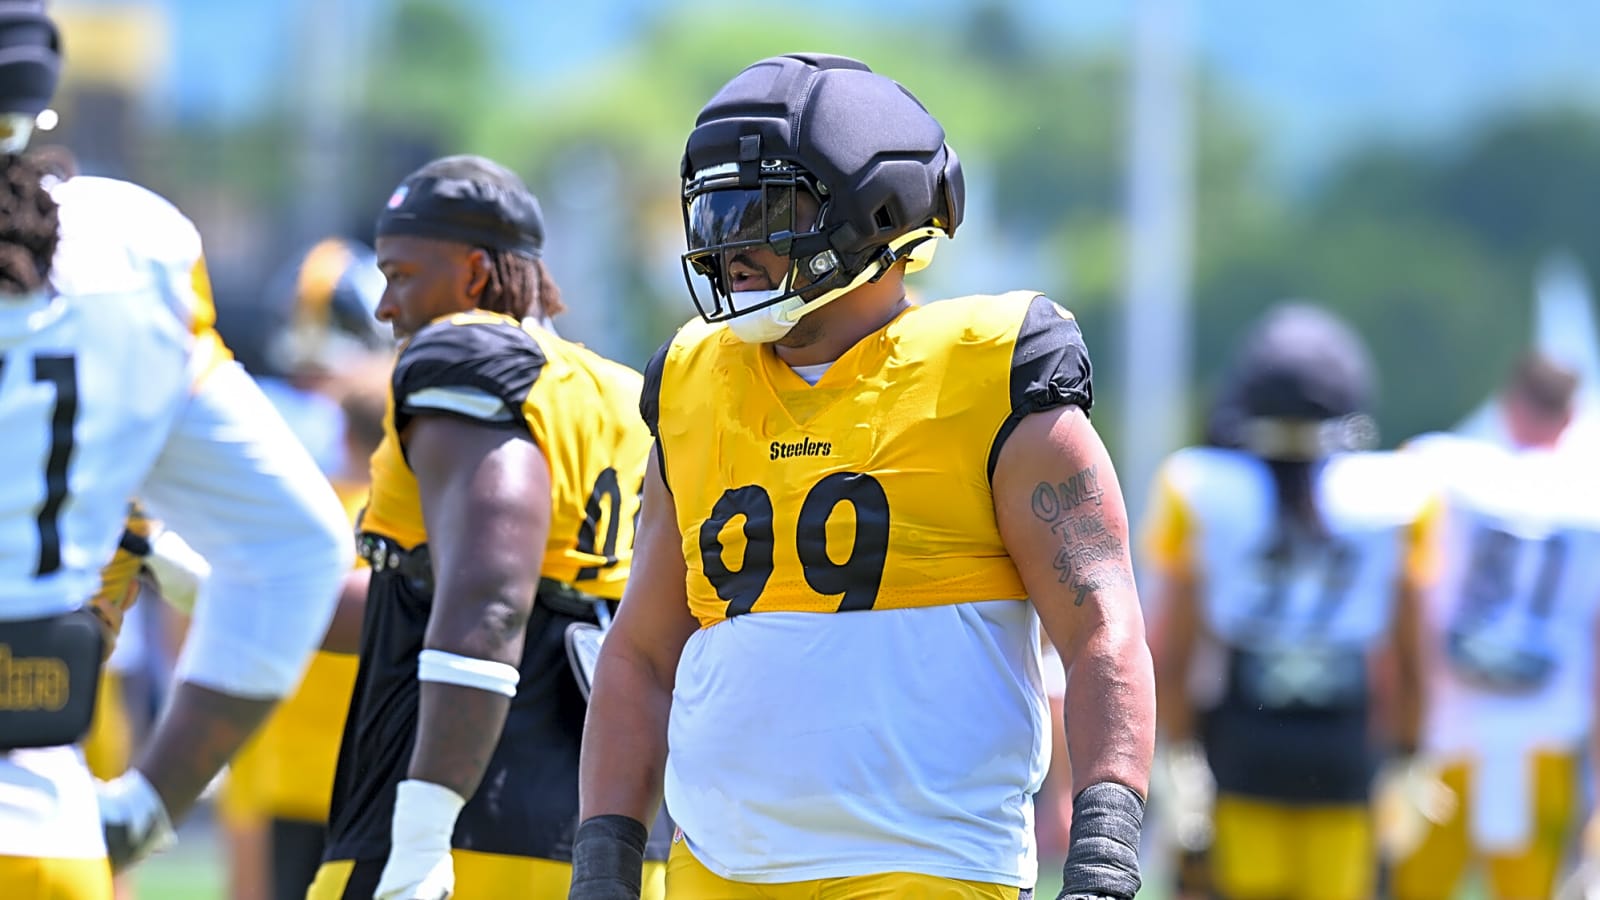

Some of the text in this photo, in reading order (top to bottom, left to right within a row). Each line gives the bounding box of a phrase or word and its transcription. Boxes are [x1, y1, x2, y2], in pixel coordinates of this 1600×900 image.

[770, 437, 832, 461] Steelers
[1031, 464, 1104, 522] ONLY
[699, 471, 891, 618] 99
[1052, 512, 1107, 544] THE
